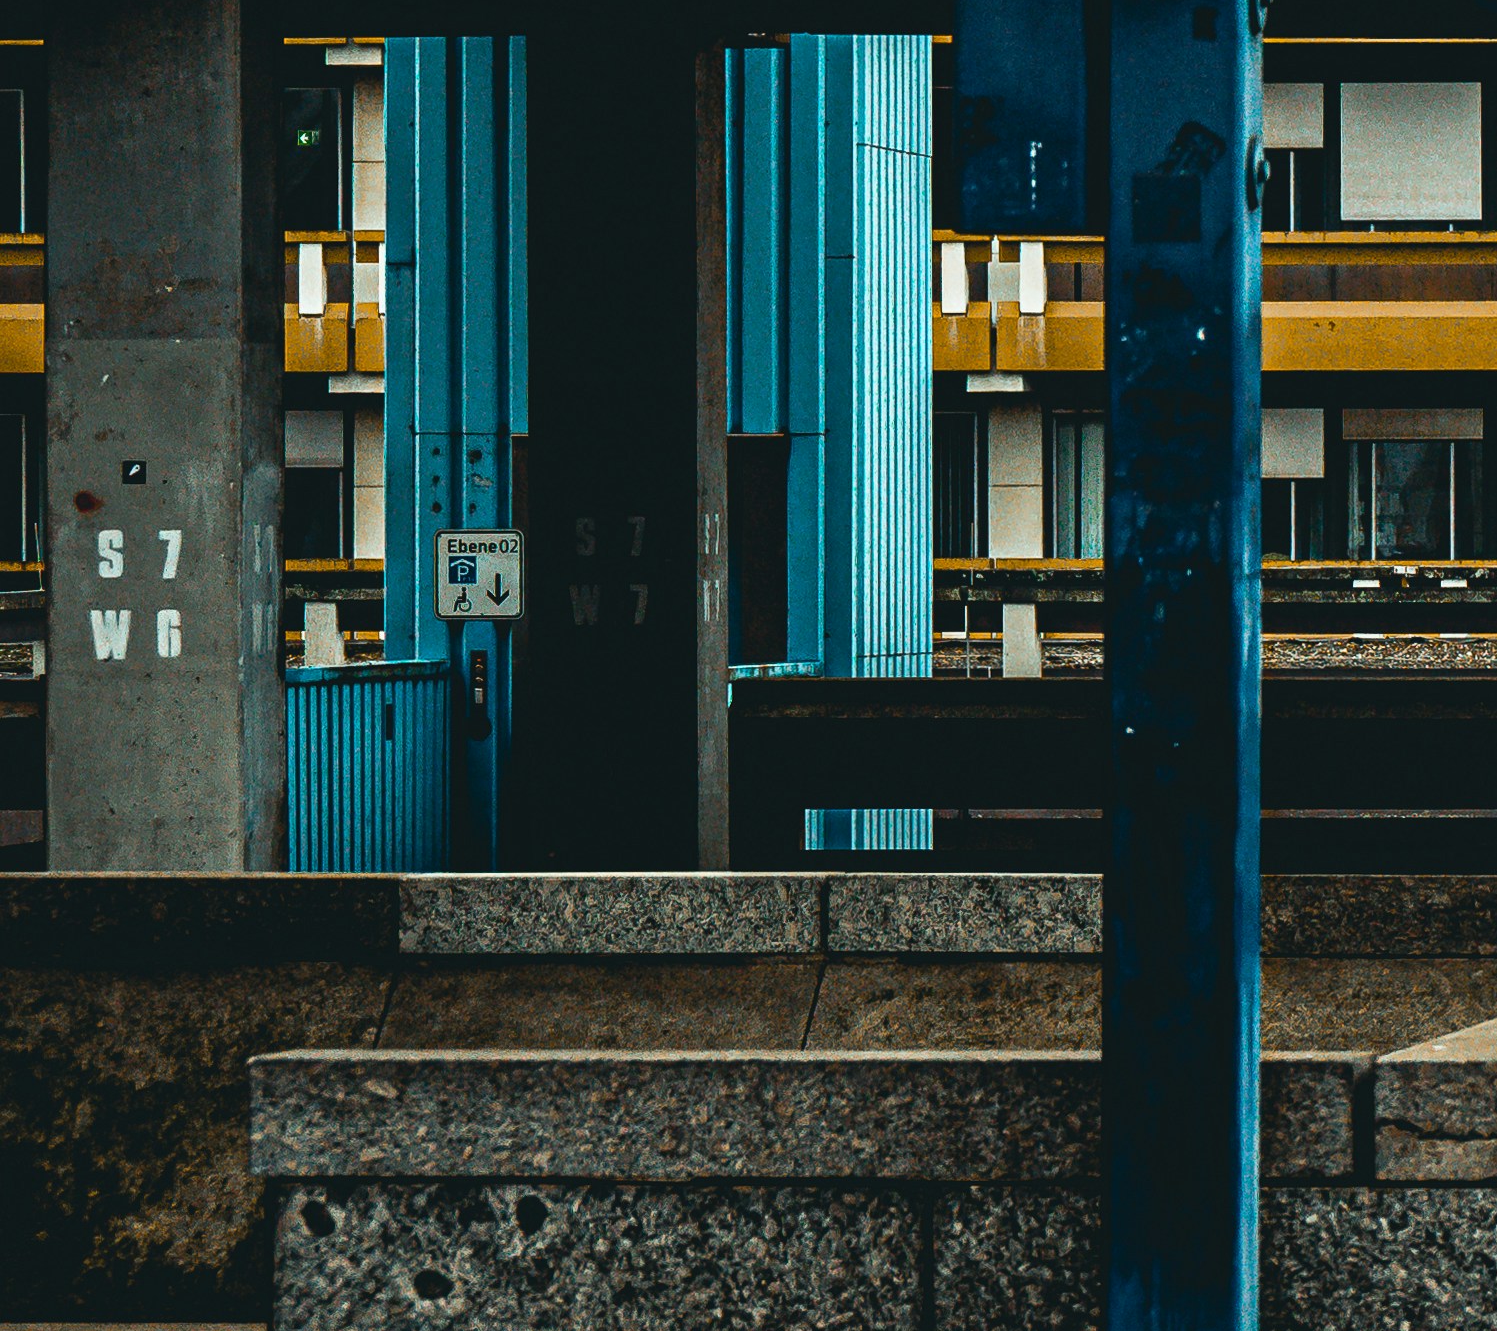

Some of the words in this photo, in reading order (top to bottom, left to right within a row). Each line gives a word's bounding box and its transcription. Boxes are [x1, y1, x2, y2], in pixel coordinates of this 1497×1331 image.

[98, 529, 124, 579] S
[158, 529, 182, 580] 7
[447, 539, 498, 554] Ebene
[499, 539, 519, 554] 02
[575, 516, 596, 557] S
[627, 516, 647, 557] 7
[568, 584, 601, 626] W
[629, 584, 649, 626] 7
[90, 610, 132, 660] W
[156, 609, 182, 658] 6
